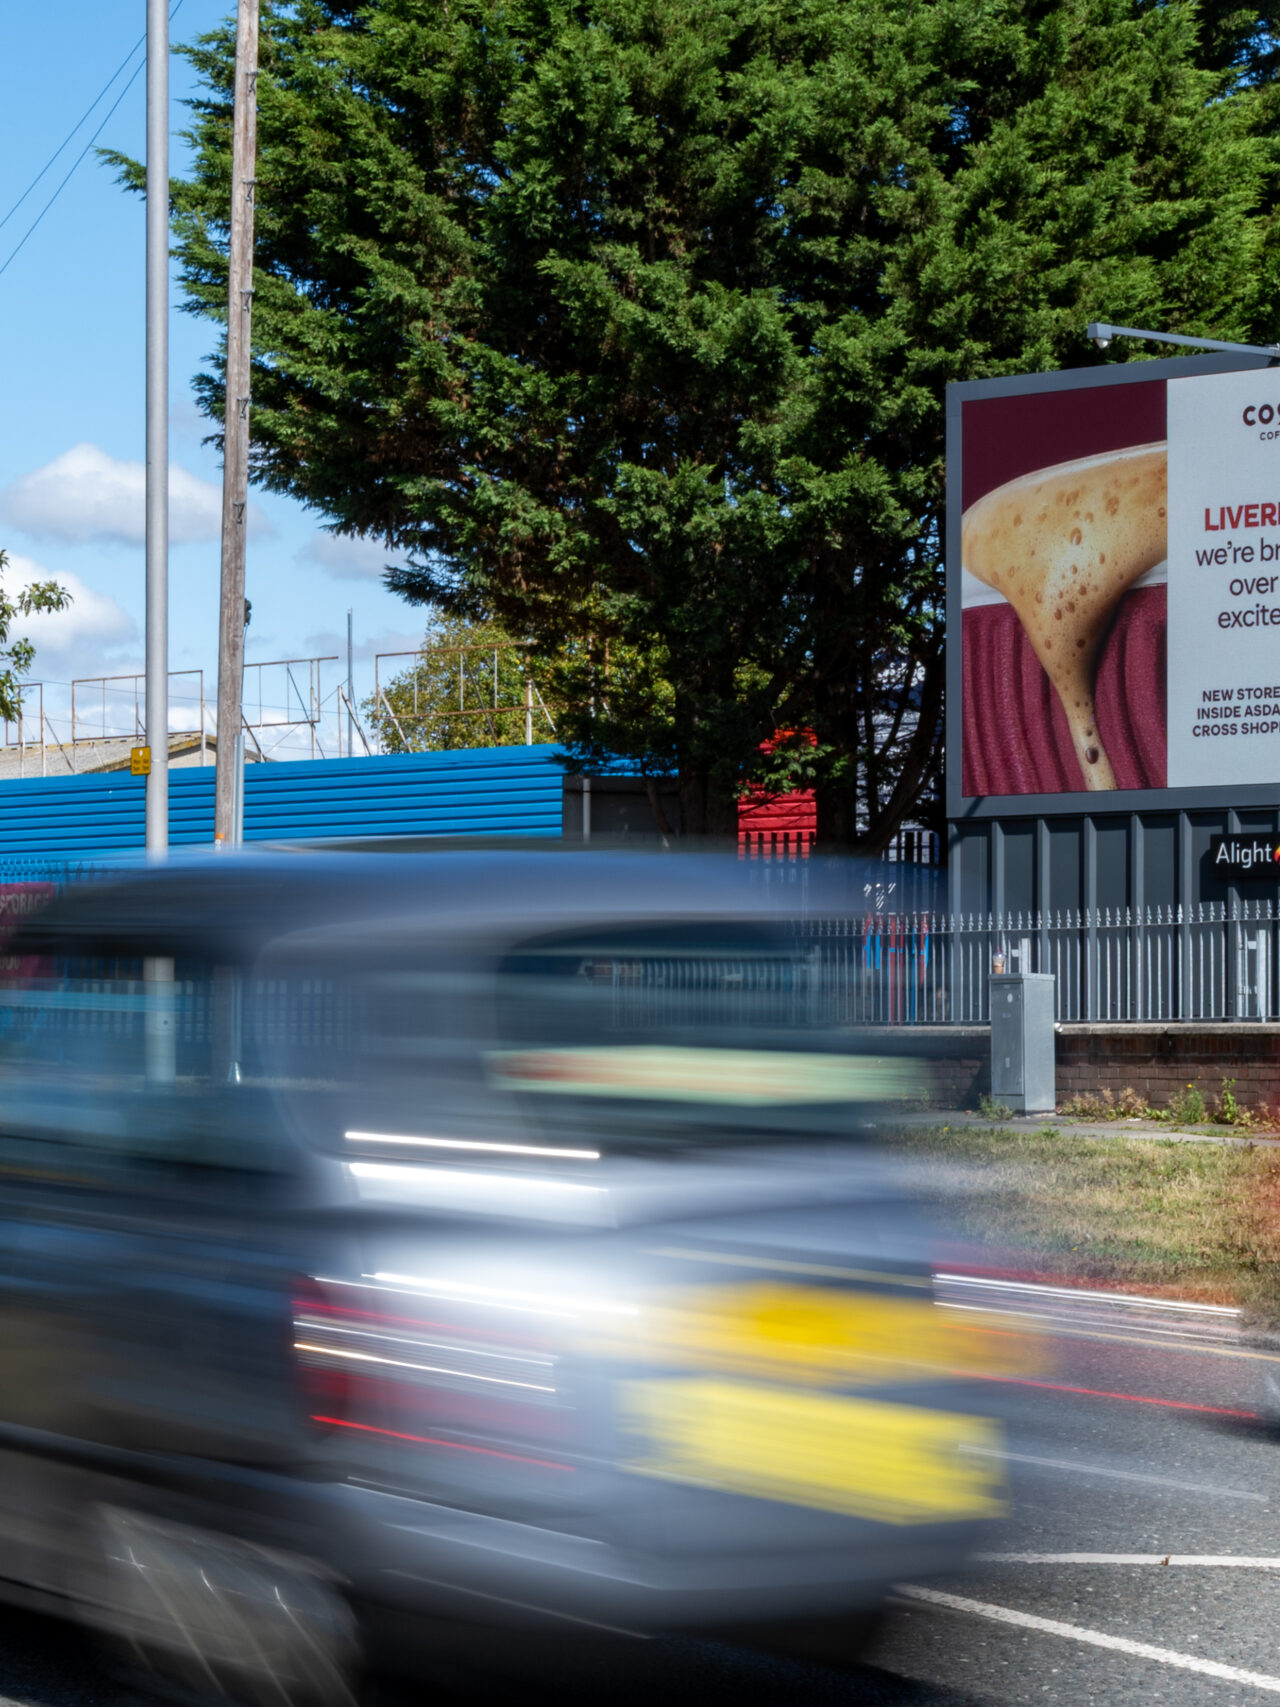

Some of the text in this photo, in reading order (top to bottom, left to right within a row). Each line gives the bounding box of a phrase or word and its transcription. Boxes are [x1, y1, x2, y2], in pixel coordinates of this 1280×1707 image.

[1195, 540, 1255, 567] we’re
[1229, 575, 1279, 597] over
[1202, 688, 1234, 703] NEW
[1197, 705, 1242, 721] INSIDE
[1192, 722, 1238, 738] CROSS
[1214, 841, 1272, 869] Alight
